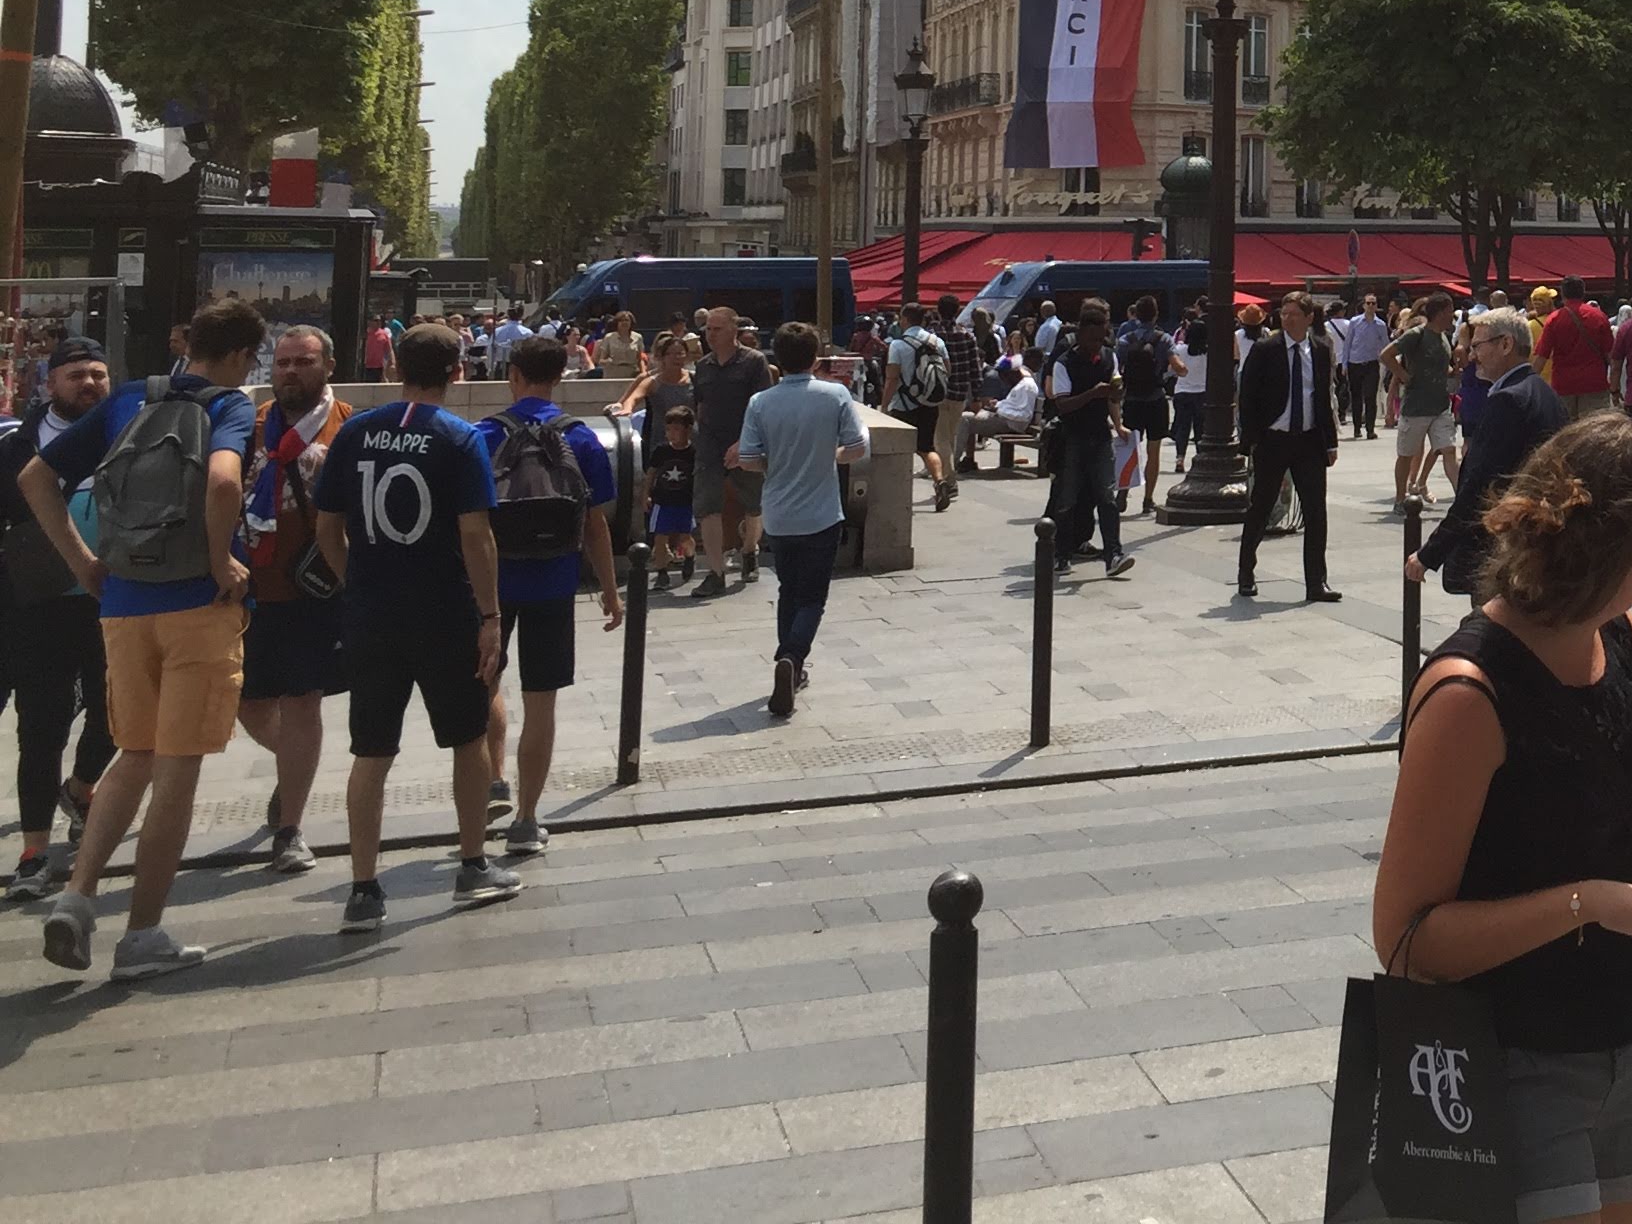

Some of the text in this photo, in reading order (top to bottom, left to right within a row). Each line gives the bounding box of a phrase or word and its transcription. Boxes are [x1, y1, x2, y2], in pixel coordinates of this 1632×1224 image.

[1006, 177, 1152, 214] Fouquet's
[244, 231, 291, 243] PRESSE
[363, 430, 433, 454] MBAPPE
[357, 460, 432, 545] 10
[1402, 1140, 1463, 1162] Abercrombie
[1473, 1148, 1497, 1165] Fitch
